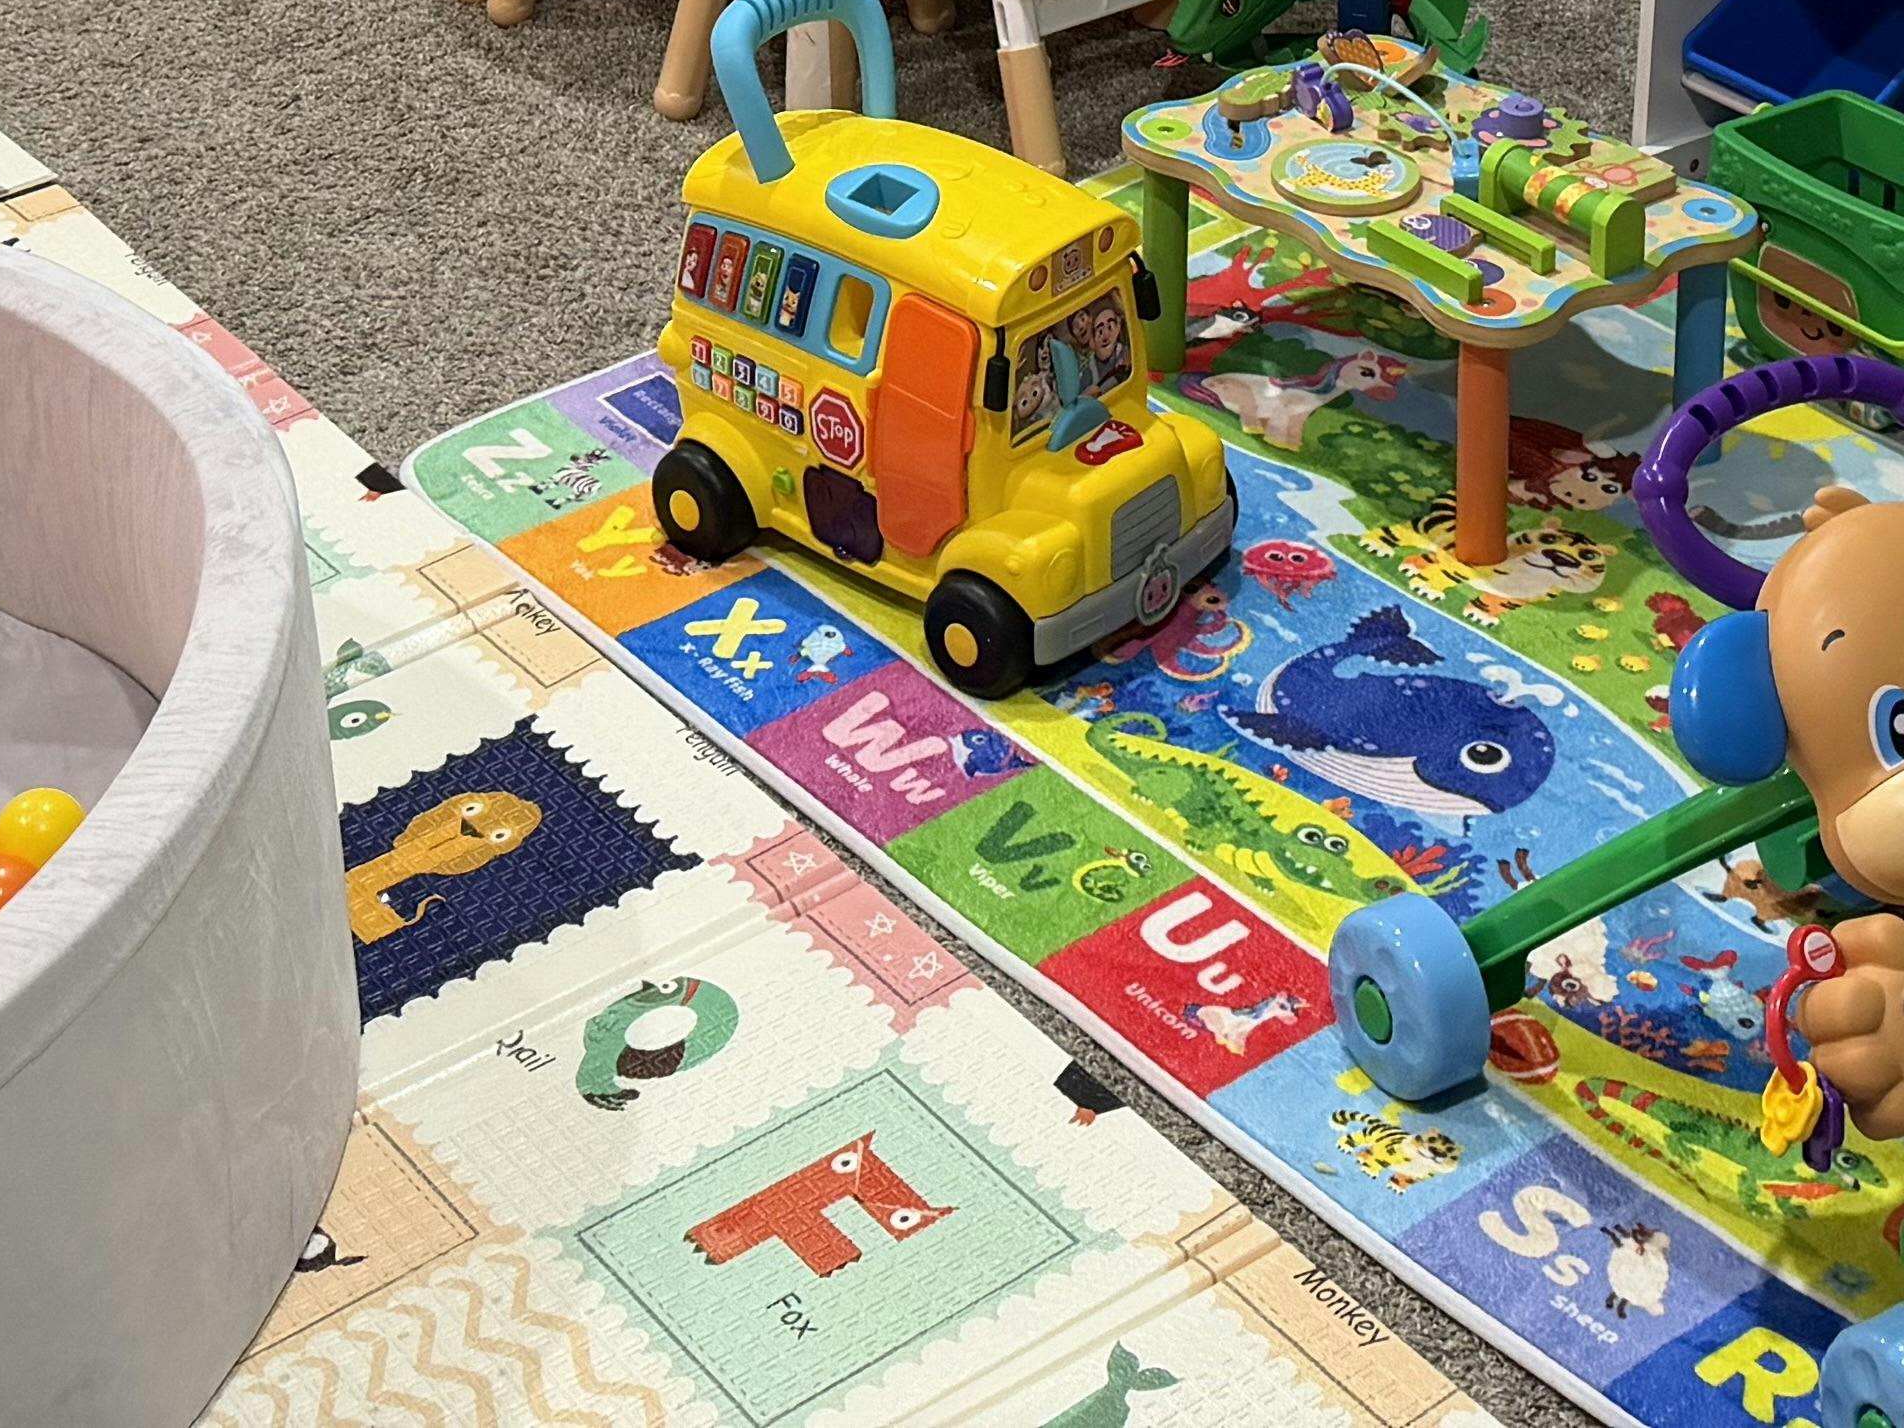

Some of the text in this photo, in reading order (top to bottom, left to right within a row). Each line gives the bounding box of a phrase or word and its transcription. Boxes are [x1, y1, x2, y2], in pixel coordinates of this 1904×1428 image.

[632, 389, 683, 427] Rectang
[967, 862, 1016, 900] Viper
[765, 1292, 819, 1341] Fox
[1292, 1264, 1391, 1350] Monkey
[1694, 1326, 1822, 1428] R
